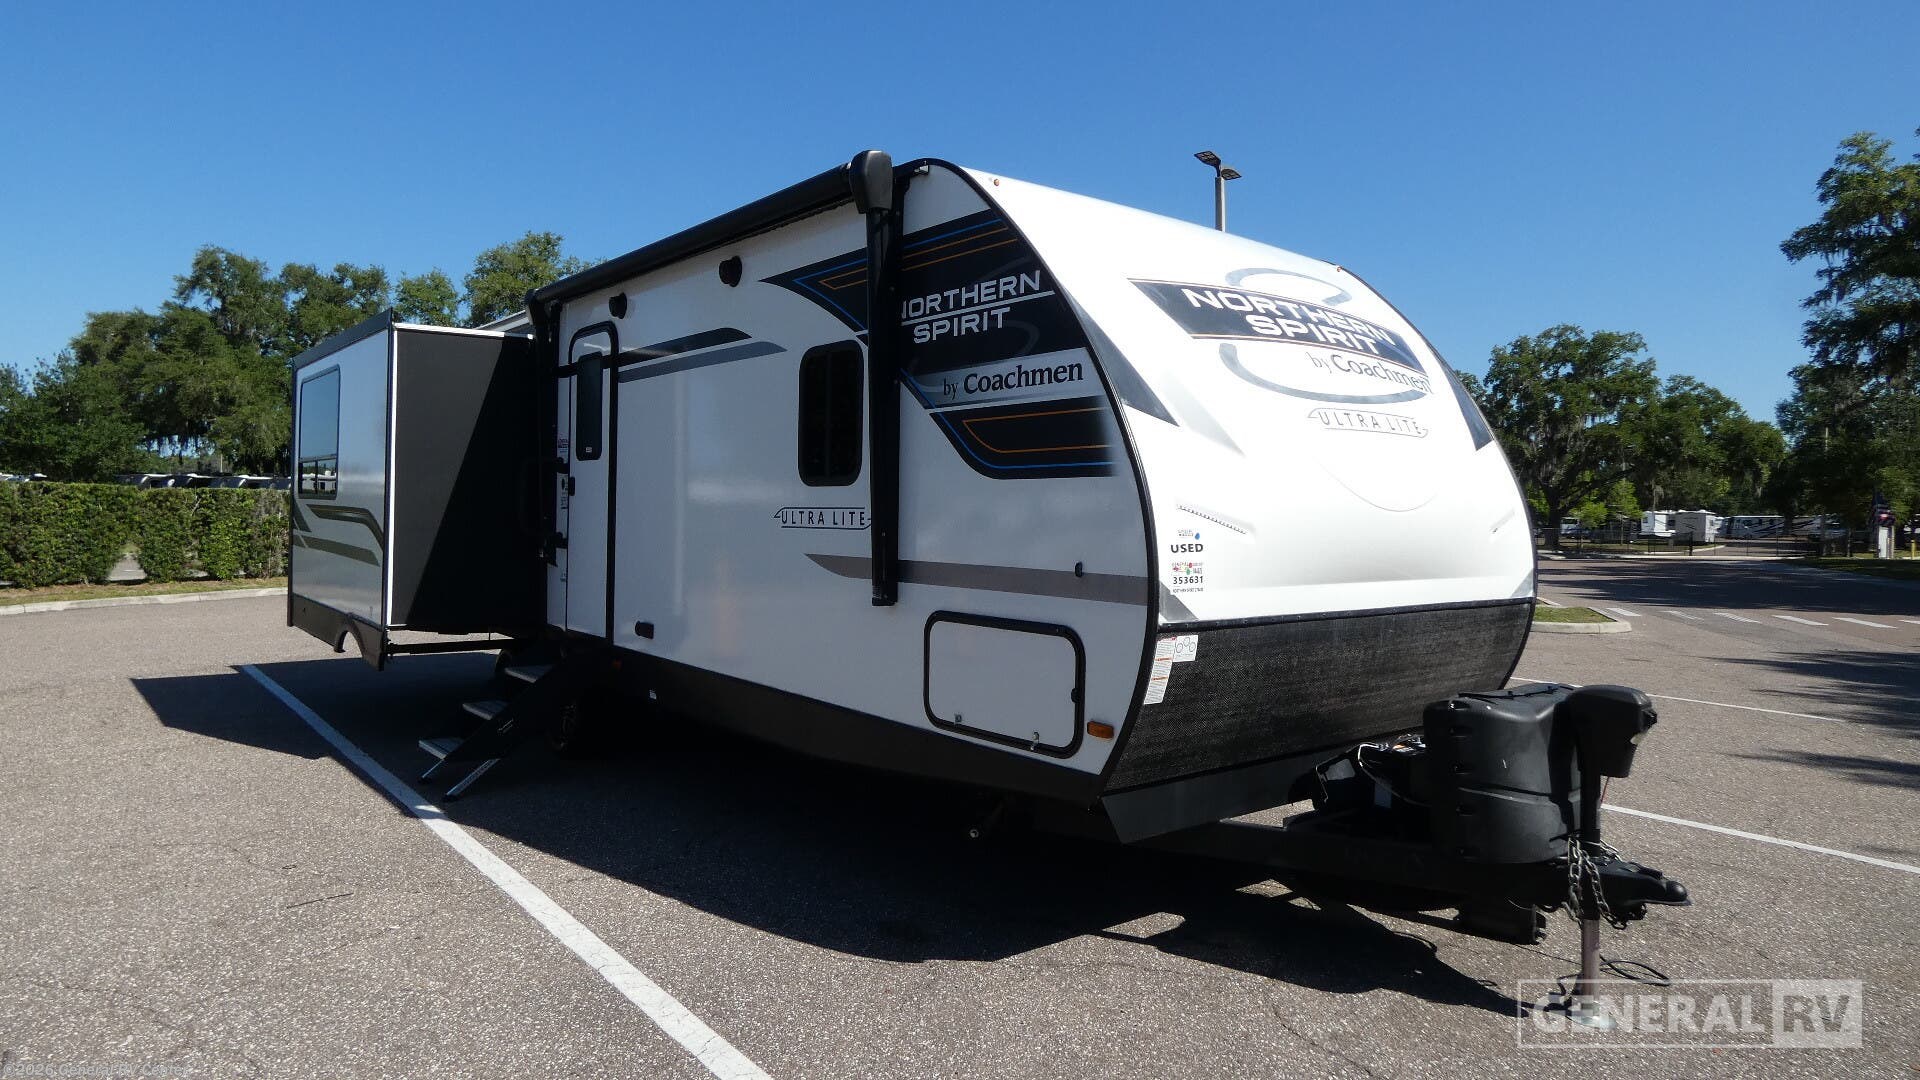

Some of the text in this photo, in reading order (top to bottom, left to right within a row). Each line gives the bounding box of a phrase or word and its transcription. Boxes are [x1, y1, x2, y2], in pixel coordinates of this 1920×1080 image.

[901, 270, 1041, 319] ORTHERN
[913, 307, 1011, 344] SPIRIT
[1181, 288, 1396, 346] NORTHERN
[1245, 314, 1380, 355] SPIRIT
[943, 362, 1084, 400] by Coachmen
[1305, 351, 1434, 395] by Coachmen
[1318, 411, 1422, 435] ULTRA LITE
[781, 510, 866, 526] ULTRA LITE
[1170, 543, 1204, 554] USED
[1172, 575, 1204, 585] 353631
